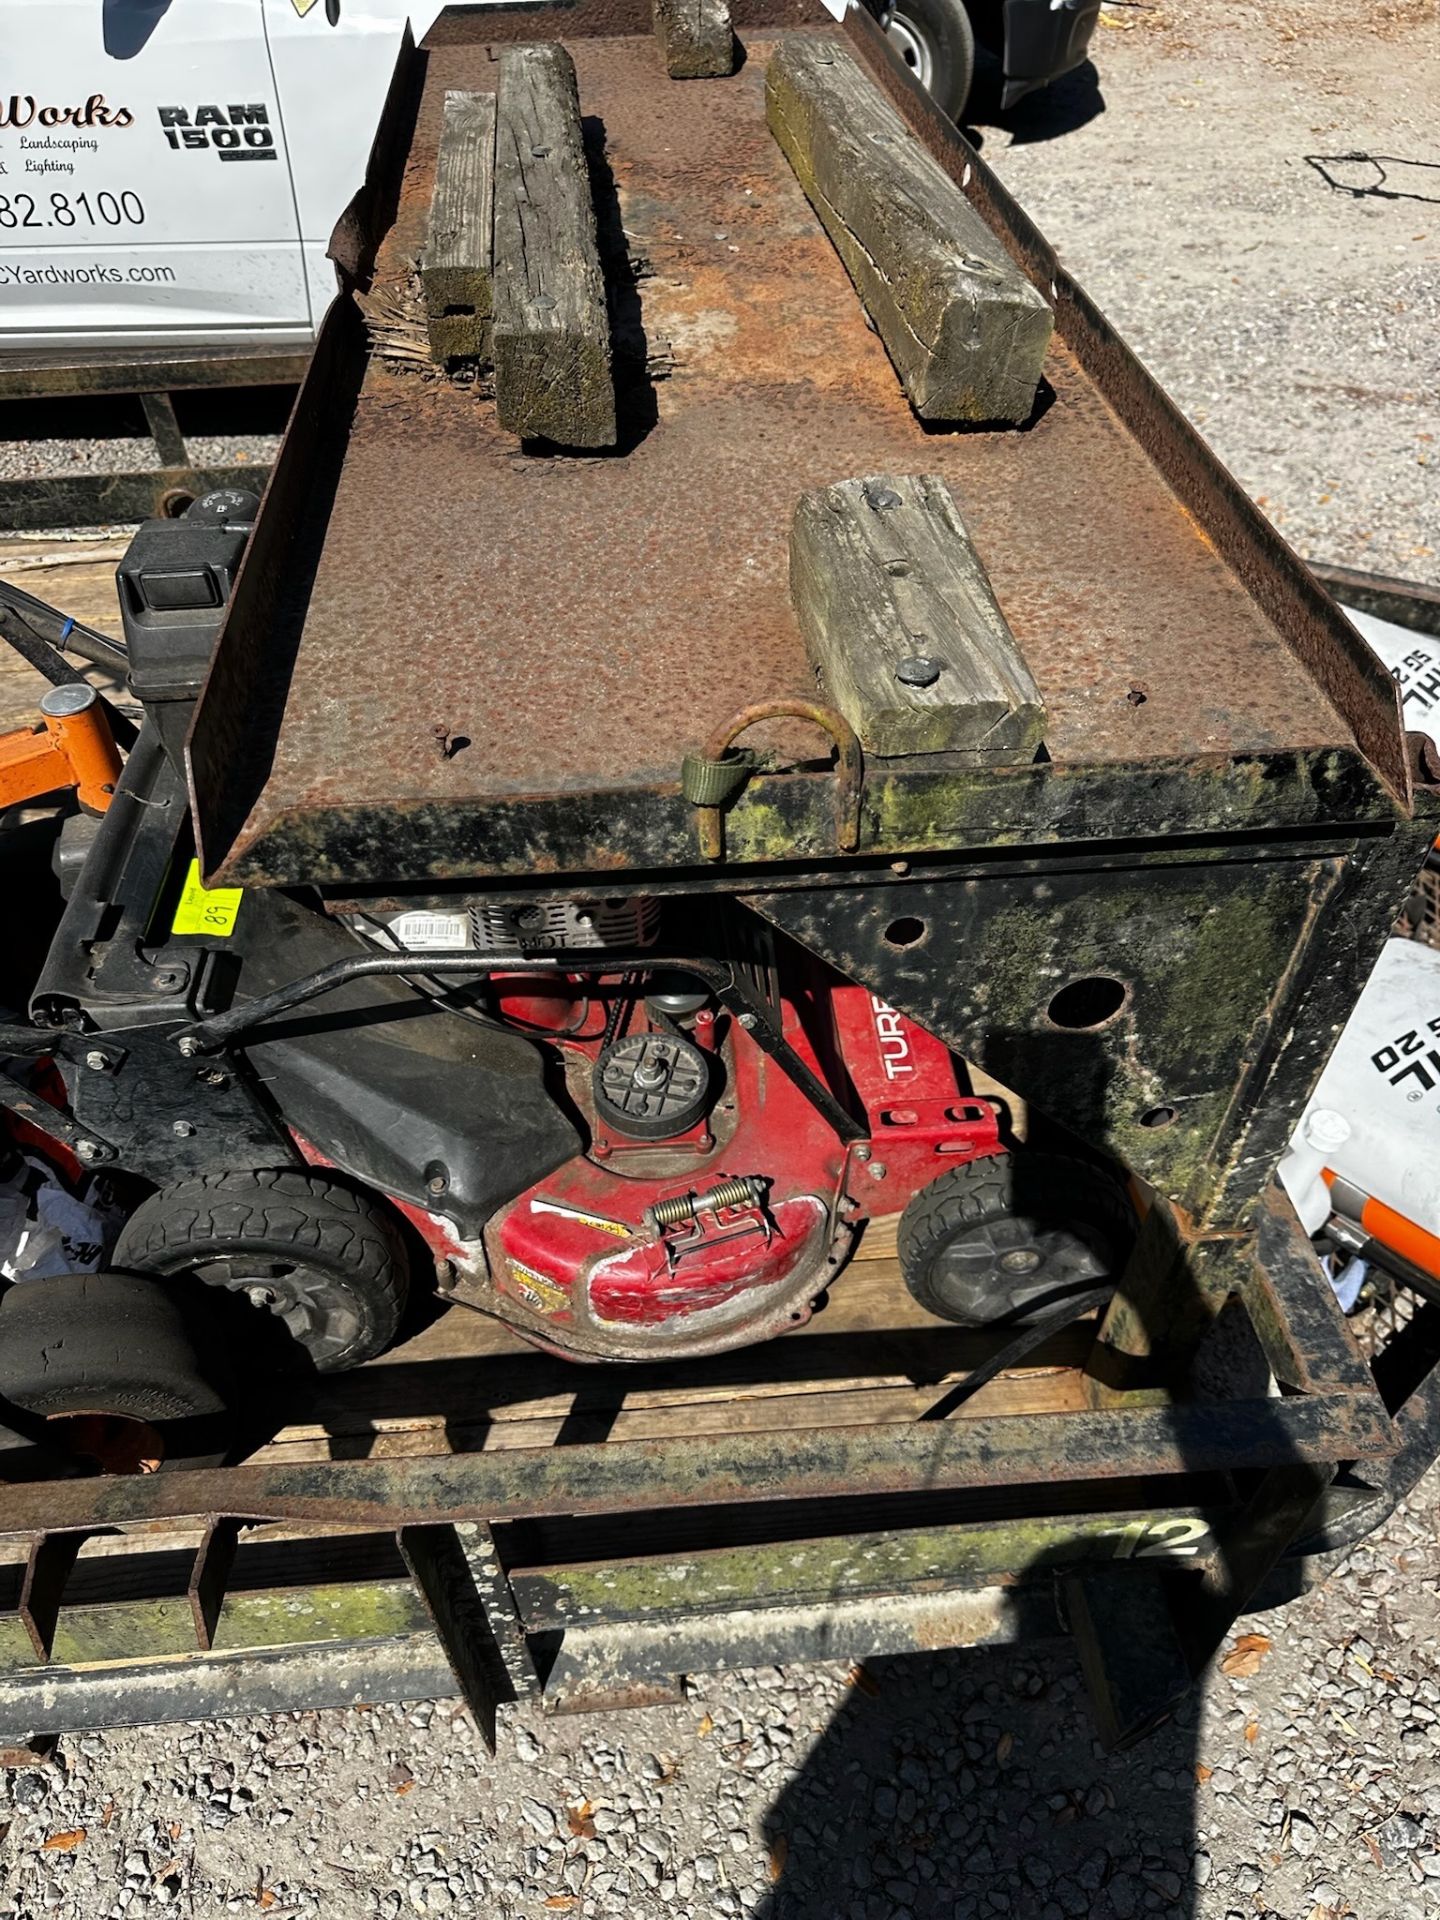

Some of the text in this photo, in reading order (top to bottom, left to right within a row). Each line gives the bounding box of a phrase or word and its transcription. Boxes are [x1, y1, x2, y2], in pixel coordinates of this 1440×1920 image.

[157, 103, 270, 127] RAM
[20, 135, 99, 153] Landscaping
[163, 127, 274, 149] 1500
[25, 158, 75, 176] Lighting
[871, 995, 913, 1080] TURF
[1370, 1029, 1425, 1073] 20
